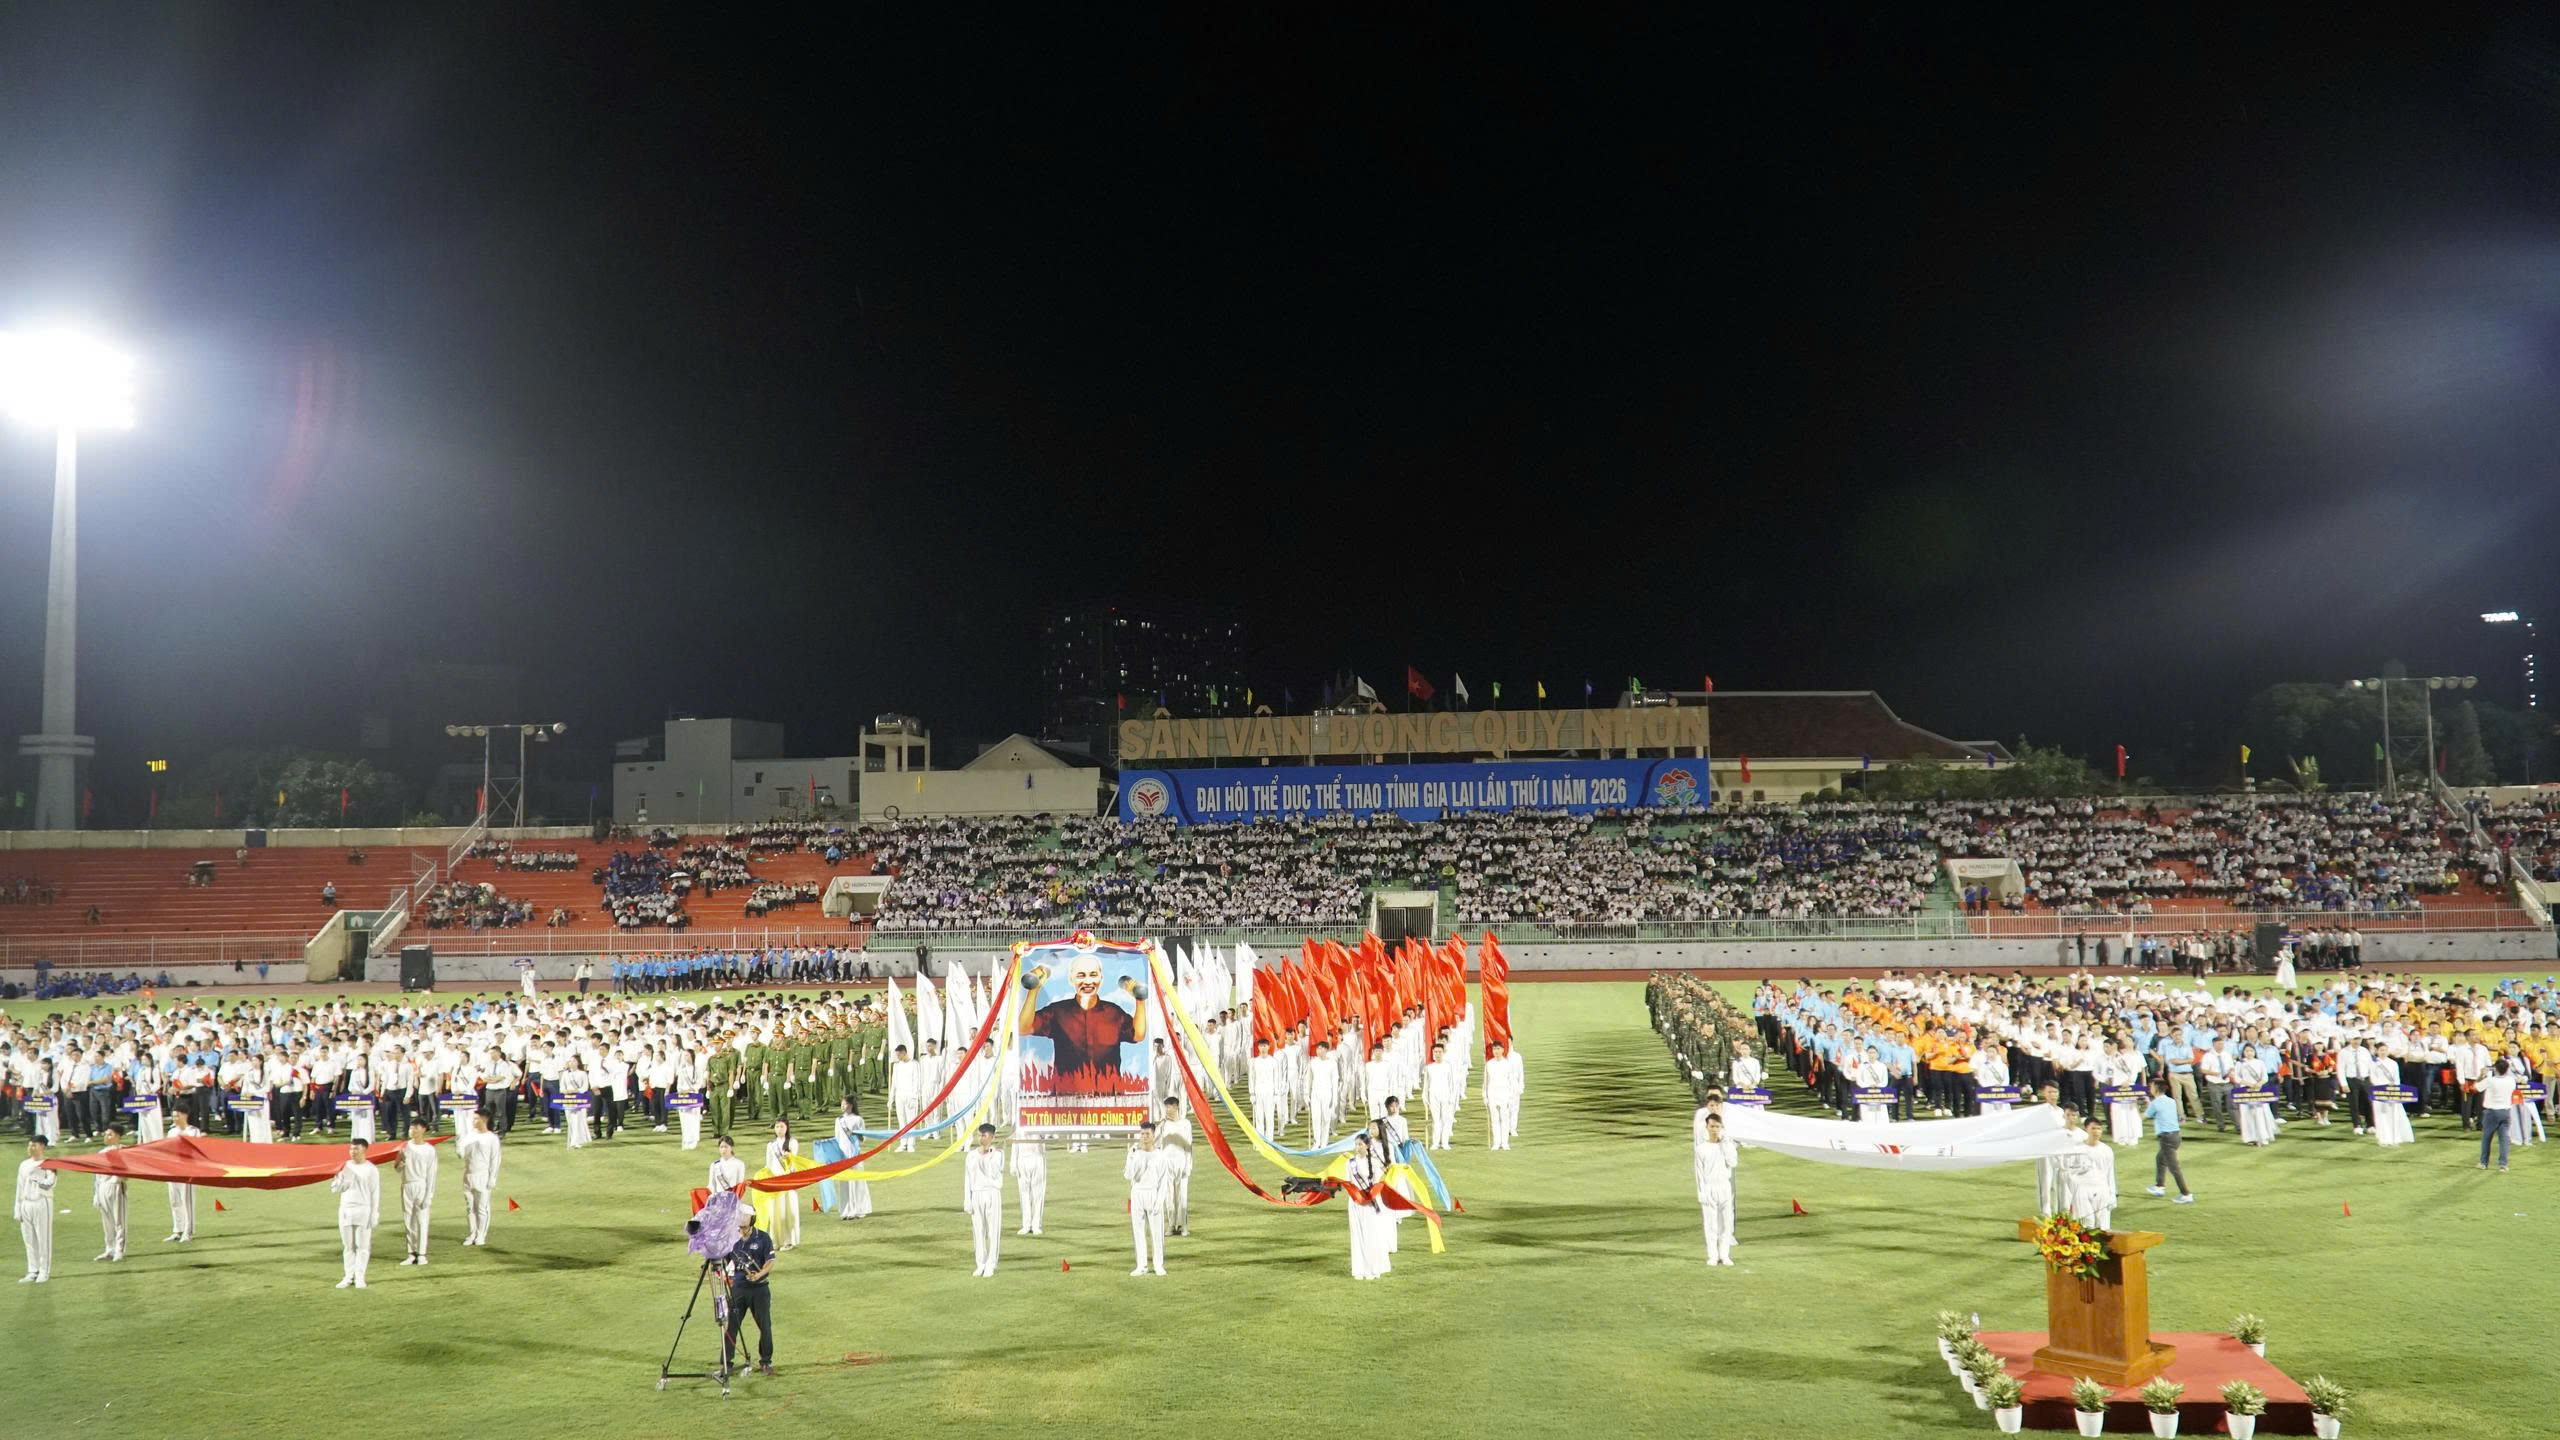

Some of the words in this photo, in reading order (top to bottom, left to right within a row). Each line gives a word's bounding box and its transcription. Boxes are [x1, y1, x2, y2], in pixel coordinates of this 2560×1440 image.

[1119, 707, 1209, 760] SÂN
[1224, 705, 1311, 765] VẬN
[1329, 702, 1459, 763] ĐỘNG
[1474, 709, 1569, 760] QUY
[1197, 786, 1221, 818] ĐẠI
[1225, 780, 1249, 817] HỘI
[1252, 774, 1279, 811] THỂ
[1315, 773, 1341, 809] THỂ
[1345, 783, 1382, 809] THAO
[1385, 774, 1419, 808] TỈNH
[1423, 781, 1448, 807] GIA
[1451, 781, 1474, 807] LAI
[1510, 774, 1540, 806] THỨ
[1542, 779, 1548, 805] I
[1552, 773, 1587, 805] NĂM
[1591, 777, 1627, 804] 2026
[1039, 1110, 1053, 1126] TÔI
[1055, 1110, 1078, 1126] NGÀY
[1080, 1110, 1098, 1126] NÀO
[1101, 1110, 1124, 1126] CŨNG
